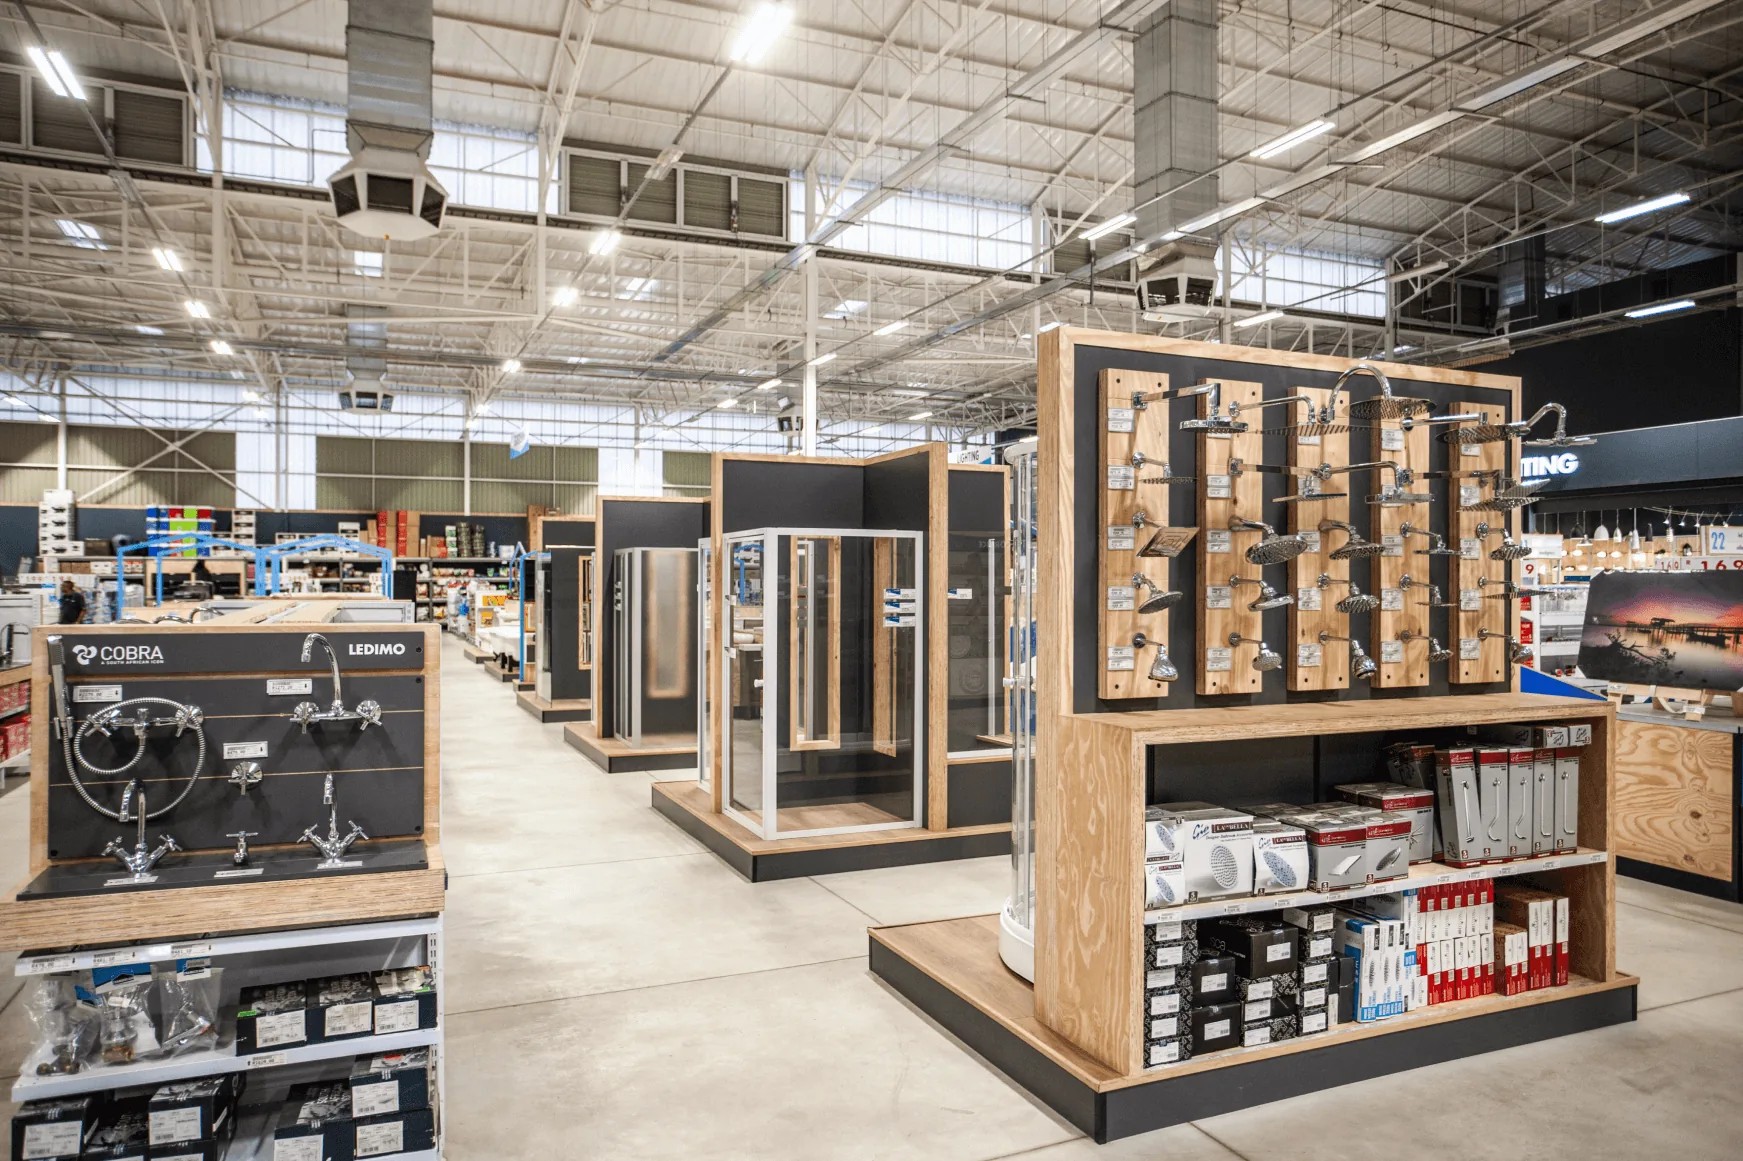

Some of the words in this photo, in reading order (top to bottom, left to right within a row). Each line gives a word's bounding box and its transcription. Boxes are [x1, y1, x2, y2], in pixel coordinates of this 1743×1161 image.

[957, 450, 979, 463] LIGHTING
[1520, 453, 1579, 477] TING
[1712, 532, 1725, 550] 22
[100, 645, 164, 661] COBRA
[348, 642, 406, 656] LEDIMO
